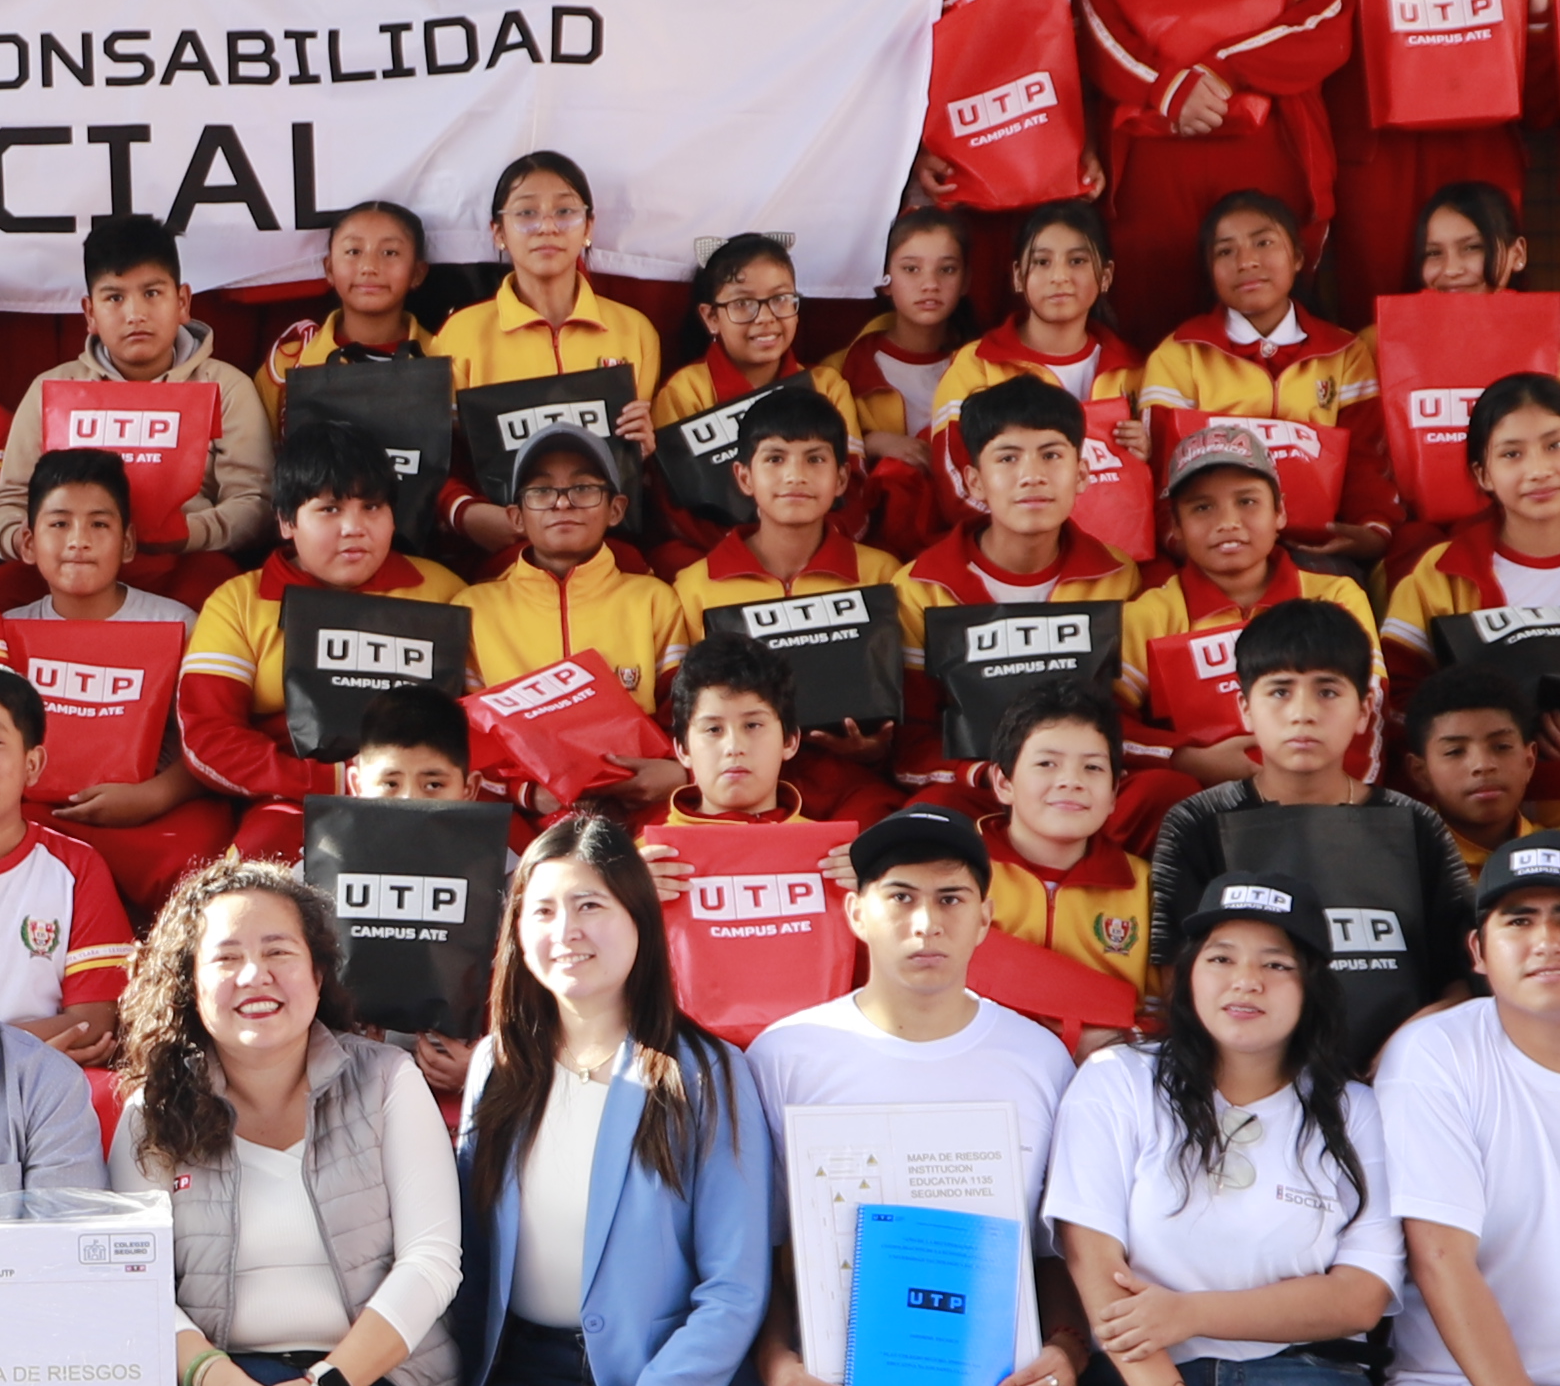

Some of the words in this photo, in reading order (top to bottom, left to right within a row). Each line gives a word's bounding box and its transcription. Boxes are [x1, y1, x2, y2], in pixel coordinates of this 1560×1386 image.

[1408, 32, 1463, 46] CAMPUS
[1465, 28, 1492, 41] ATE
[957, 81, 1048, 127] UTP
[970, 122, 1022, 147] CAMPUS
[1023, 114, 1048, 128] ATE
[76, 418, 171, 439] UTP
[136, 452, 162, 463] ATE
[1099, 470, 1120, 483] ATE
[754, 597, 855, 627] UTP
[769, 632, 829, 649] CAMPUS
[831, 628, 860, 642] ATE
[976, 621, 1079, 653] UTP
[326, 639, 425, 665] UTP
[984, 661, 1046, 677] CAMPUS
[1048, 658, 1077, 671] ATE
[36, 667, 135, 695] UTP
[332, 675, 390, 690] CAMPUS
[495, 667, 578, 708] UTP
[98, 704, 124, 716] ATE
[524, 696, 570, 720] CAMPUS
[571, 687, 596, 704] ATE
[346, 882, 458, 913] UTP
[699, 882, 814, 911] UTP
[1229, 889, 1287, 905] UTP
[351, 925, 416, 940] CAMPUS
[418, 928, 448, 942] ATE
[710, 924, 778, 938] CAMPUS
[780, 920, 812, 934] ATE
[1370, 958, 1398, 971] ATE
[907, 1153, 937, 1163] MAPA
[939, 1152, 953, 1162] DE
[955, 1151, 1002, 1161] RIESGOS
[908, 1165, 973, 1174] INSTITUCION
[909, 1177, 968, 1187] EDUCATIVA
[971, 1176, 994, 1185] 1135
[911, 1189, 963, 1199] SEGUNDO
[965, 1188, 995, 1197] NIVEL
[1284, 1192, 1335, 1214] SOCIAL
[910, 1291, 963, 1309] UTP
[13, 1366, 40, 1382] DE
[48, 1364, 142, 1382] RIESGOS
